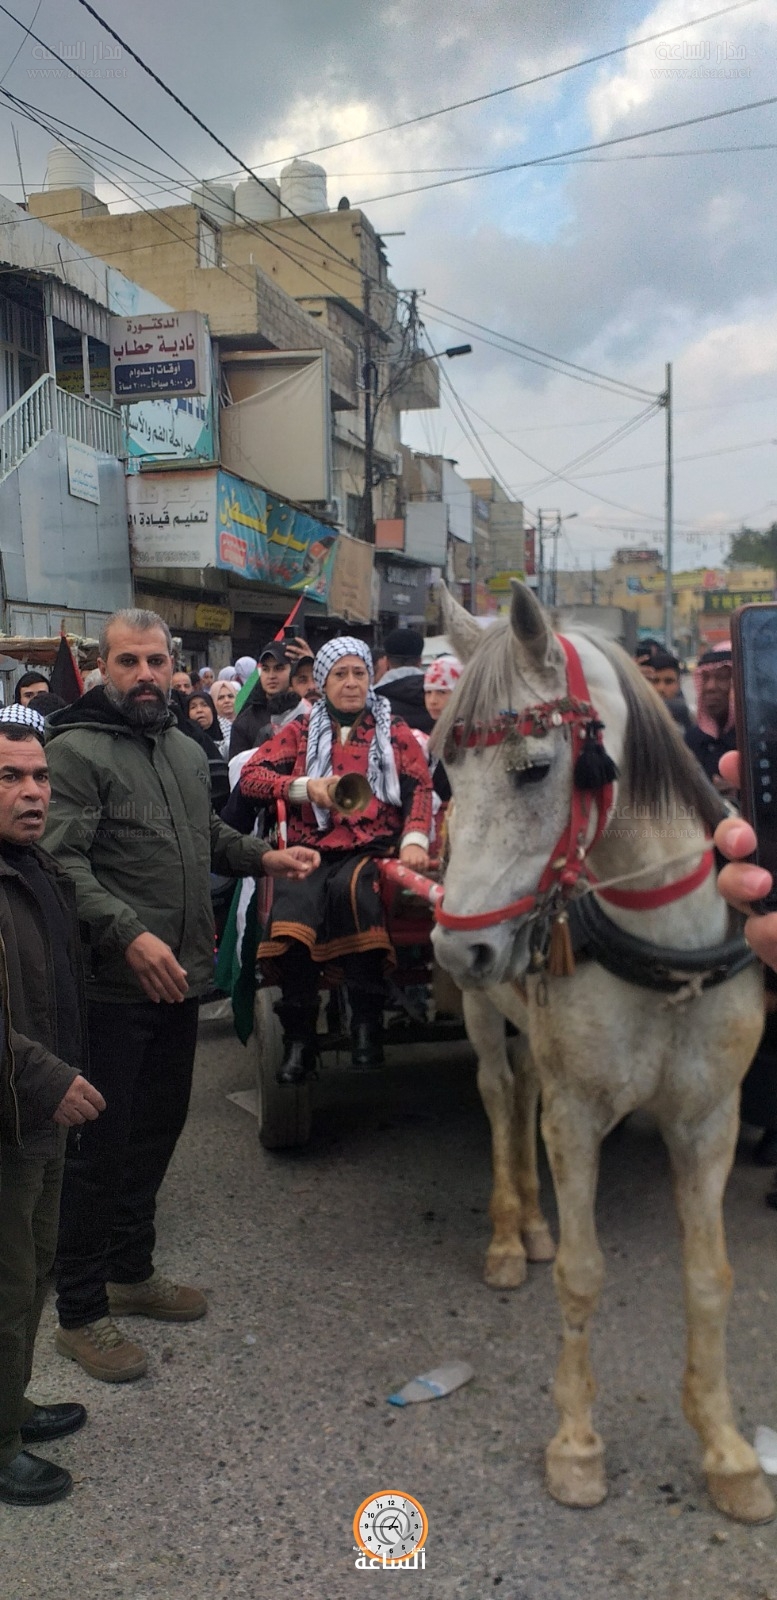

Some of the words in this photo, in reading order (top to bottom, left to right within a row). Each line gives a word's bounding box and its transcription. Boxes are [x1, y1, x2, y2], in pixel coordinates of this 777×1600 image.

[127, 317, 179, 334] الدكتورة
[114, 339, 153, 361] حطاب
[159, 333, 195, 357] نادية
[129, 366, 154, 378] الدوام
[157, 363, 181, 374] أوقات
[184, 378, 193, 387] من
[140, 511, 170, 528] قيادة
[173, 511, 209, 528] لتعليم
